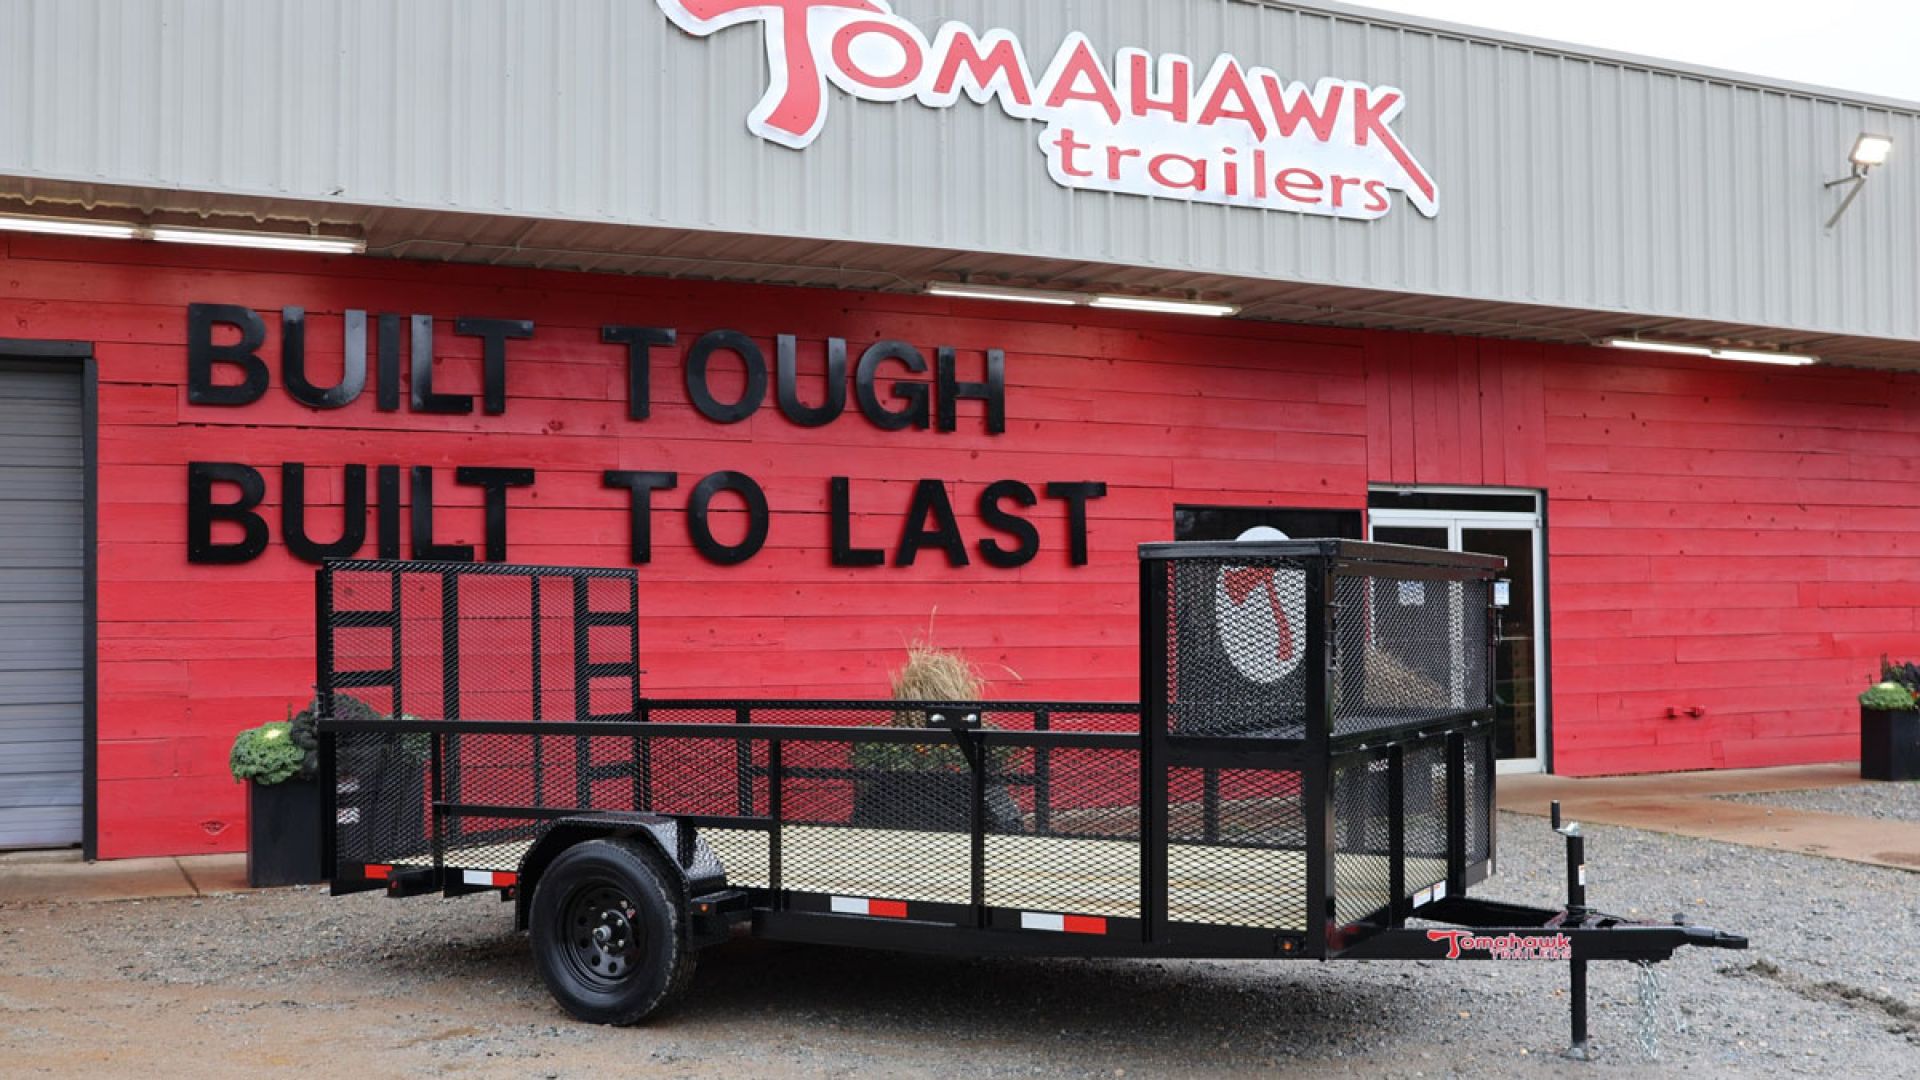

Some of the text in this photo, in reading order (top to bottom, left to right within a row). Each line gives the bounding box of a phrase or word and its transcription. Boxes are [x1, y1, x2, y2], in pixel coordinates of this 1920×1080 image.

[674, 0, 1435, 203] TOMAHAWK
[1053, 128, 1389, 212] trailers
[188, 303, 1006, 435] BUILT TOUGH
[187, 461, 1107, 569] BUILT TO LAST
[1427, 930, 1571, 958] Tomahawk
